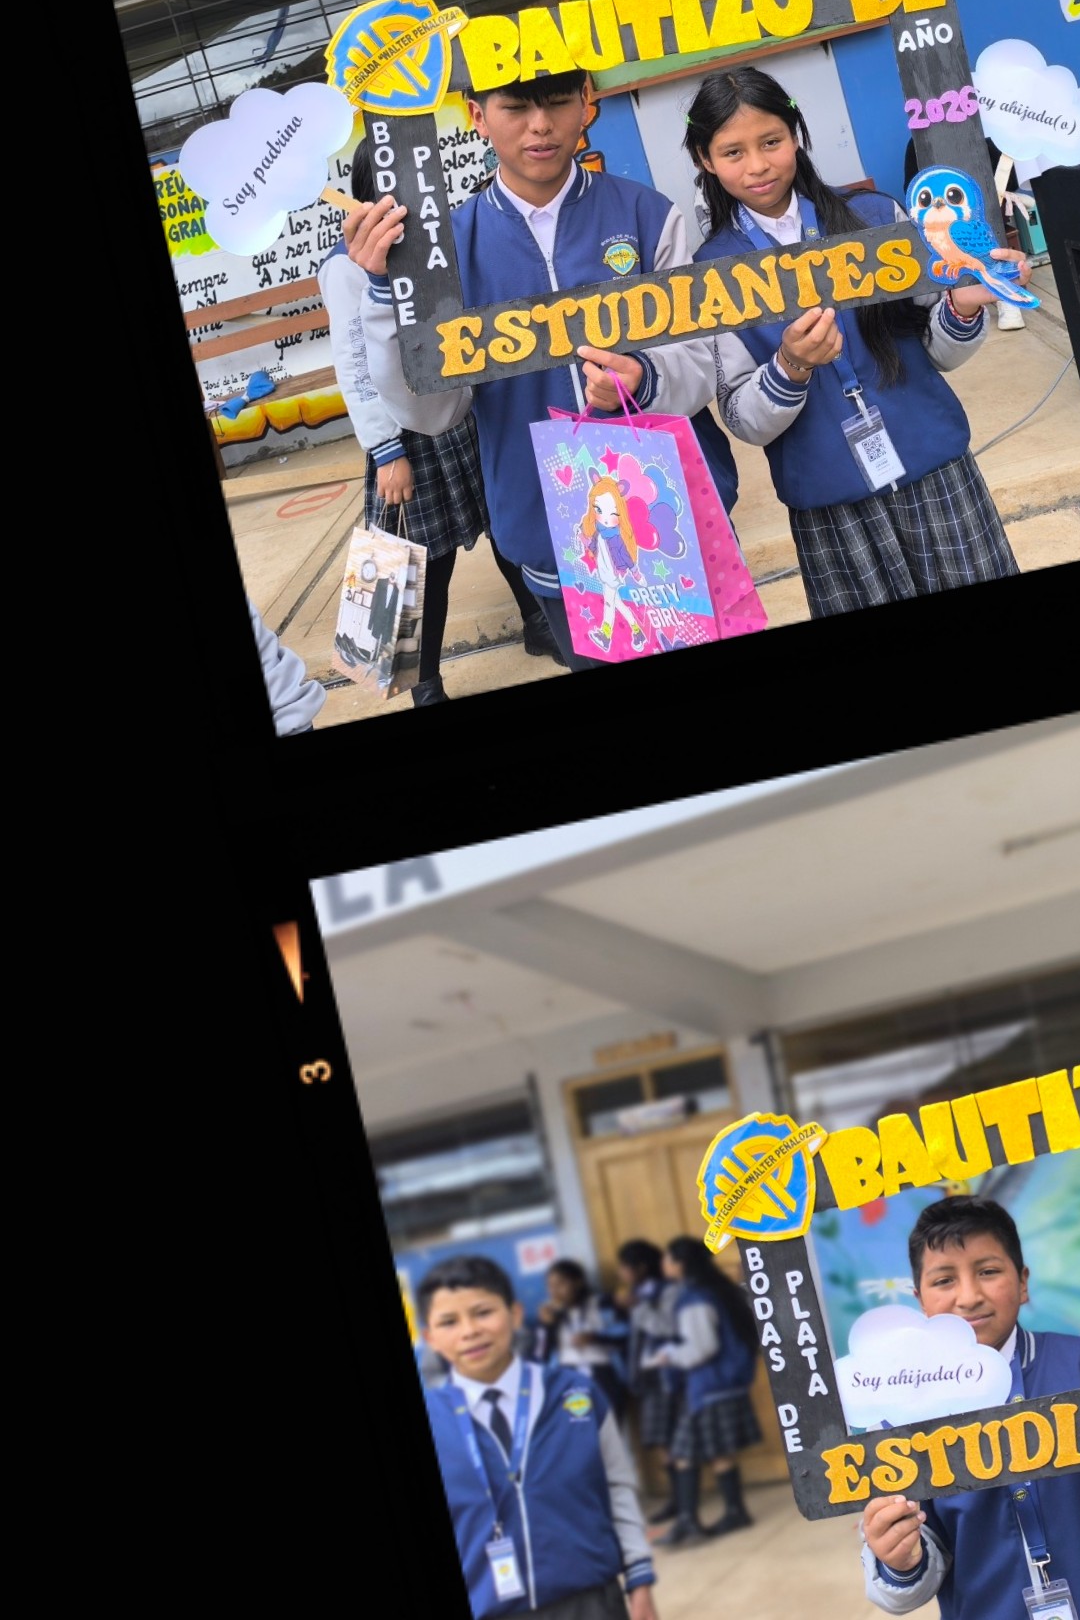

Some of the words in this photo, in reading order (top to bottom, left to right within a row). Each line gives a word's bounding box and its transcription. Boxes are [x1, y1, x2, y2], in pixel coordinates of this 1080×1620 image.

[897, 17, 954, 53] AÑO
[342, 59, 381, 99] NTEGRADA
[904, 84, 980, 130] 2026
[221, 182, 257, 217] Soy
[252, 115, 304, 186] padrino
[288, 214, 313, 236] los
[412, 145, 449, 270] PLATA
[251, 252, 278, 276] que
[258, 267, 273, 289] A
[392, 276, 417, 327] DE
[434, 238, 922, 379] ESTUDIANTES
[628, 582, 682, 608] PRETY
[646, 606, 685, 629] GIRL
[713, 1185, 749, 1230] INTEGRADA
[745, 1154, 778, 1185] "WALTER
[745, 1246, 787, 1373] BODAS
[777, 1403, 804, 1454] DE
[785, 1269, 829, 1398] PLATA
[851, 1370, 883, 1393] Soy
[887, 1361, 985, 1389] ahijada(o)
